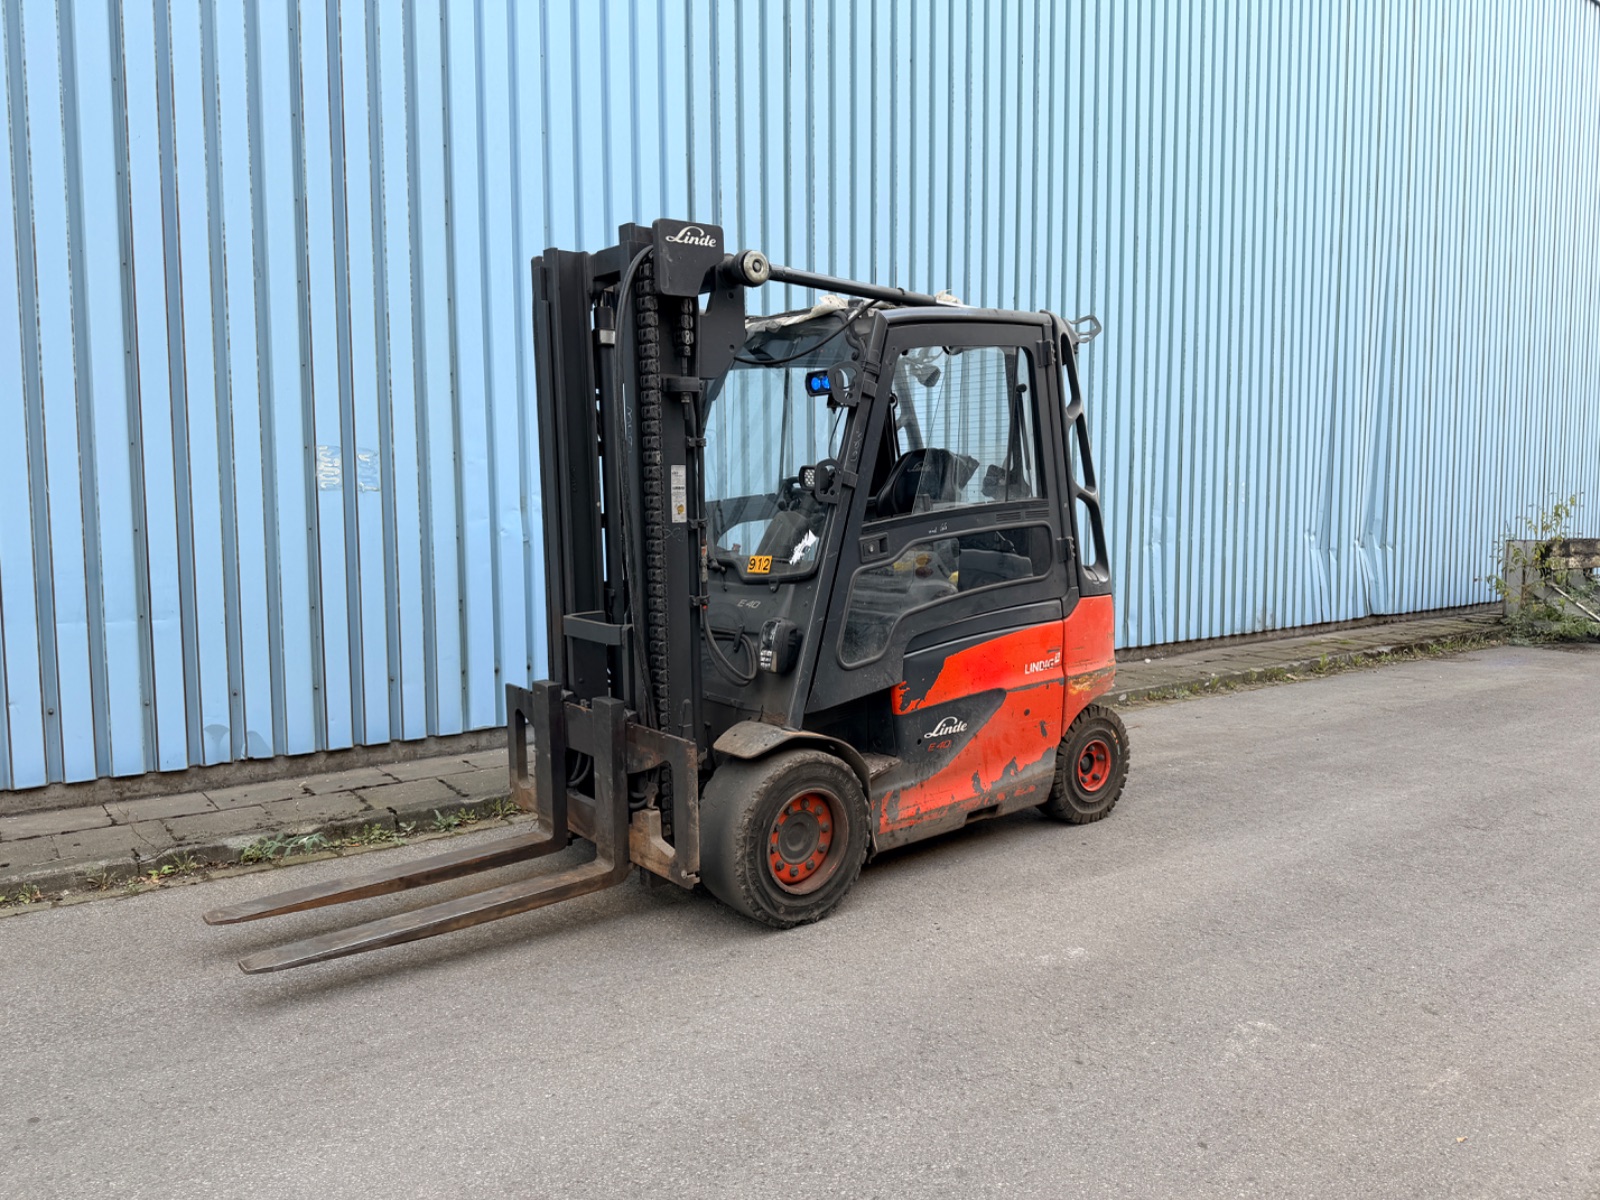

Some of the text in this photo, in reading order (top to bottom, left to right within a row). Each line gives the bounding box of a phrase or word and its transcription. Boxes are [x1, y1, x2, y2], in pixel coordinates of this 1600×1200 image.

[665, 225, 717, 247] Linde
[749, 558, 770, 571] 912
[924, 716, 968, 738] Linde
